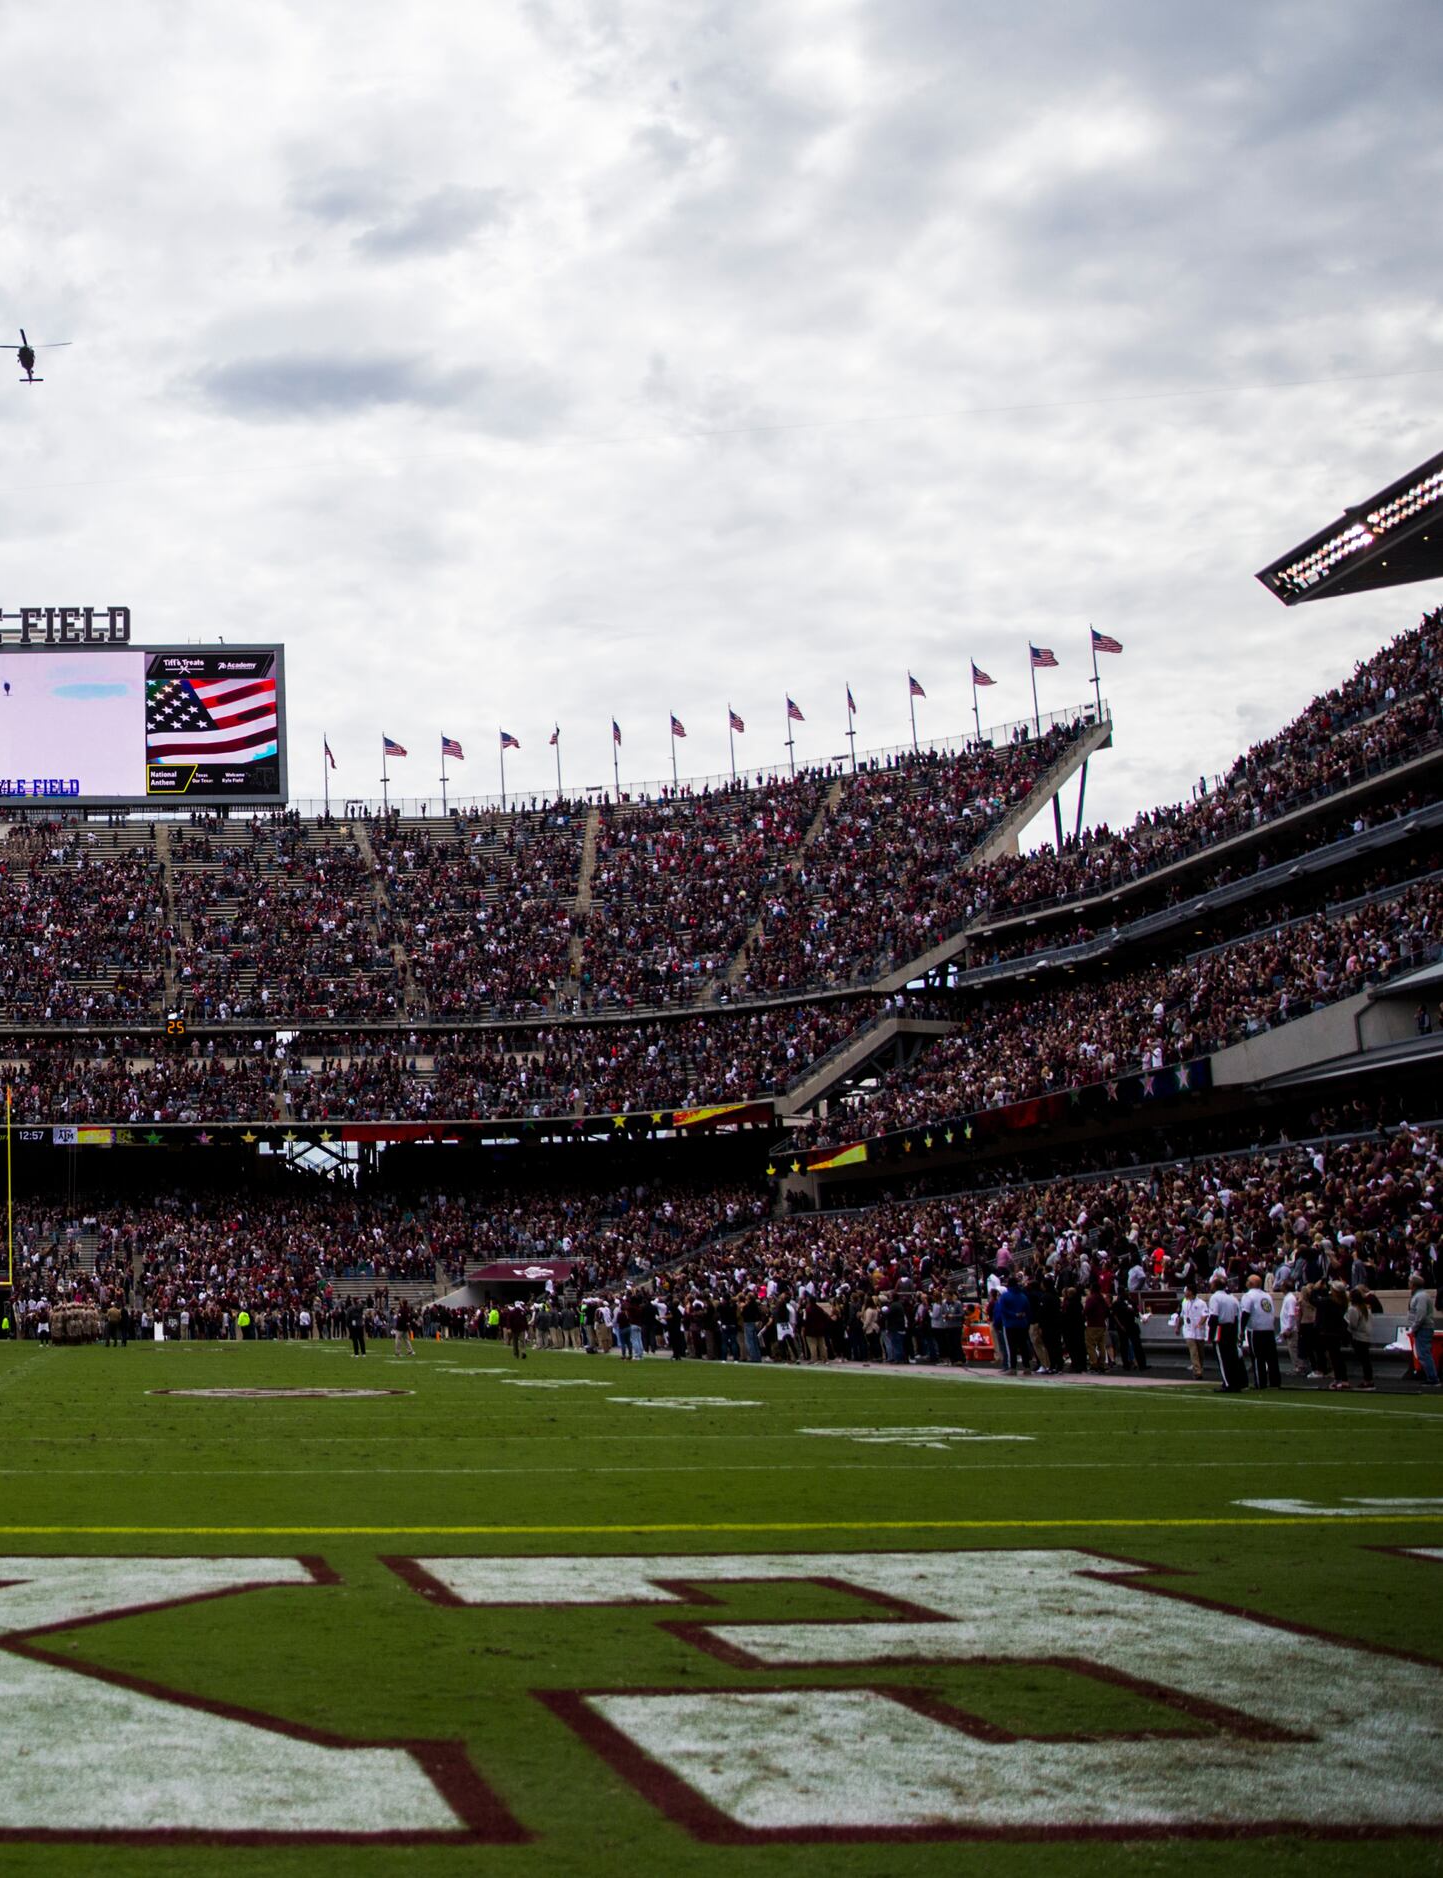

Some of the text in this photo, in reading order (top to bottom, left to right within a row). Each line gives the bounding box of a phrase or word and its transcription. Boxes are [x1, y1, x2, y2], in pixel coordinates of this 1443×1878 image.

[20, 606, 130, 643] FIELD
[227, 662, 256, 670] Academy
[33, 779, 79, 796] FIELD
[167, 1021, 185, 1034] 25
[19, 1131, 44, 1140] 12:57
